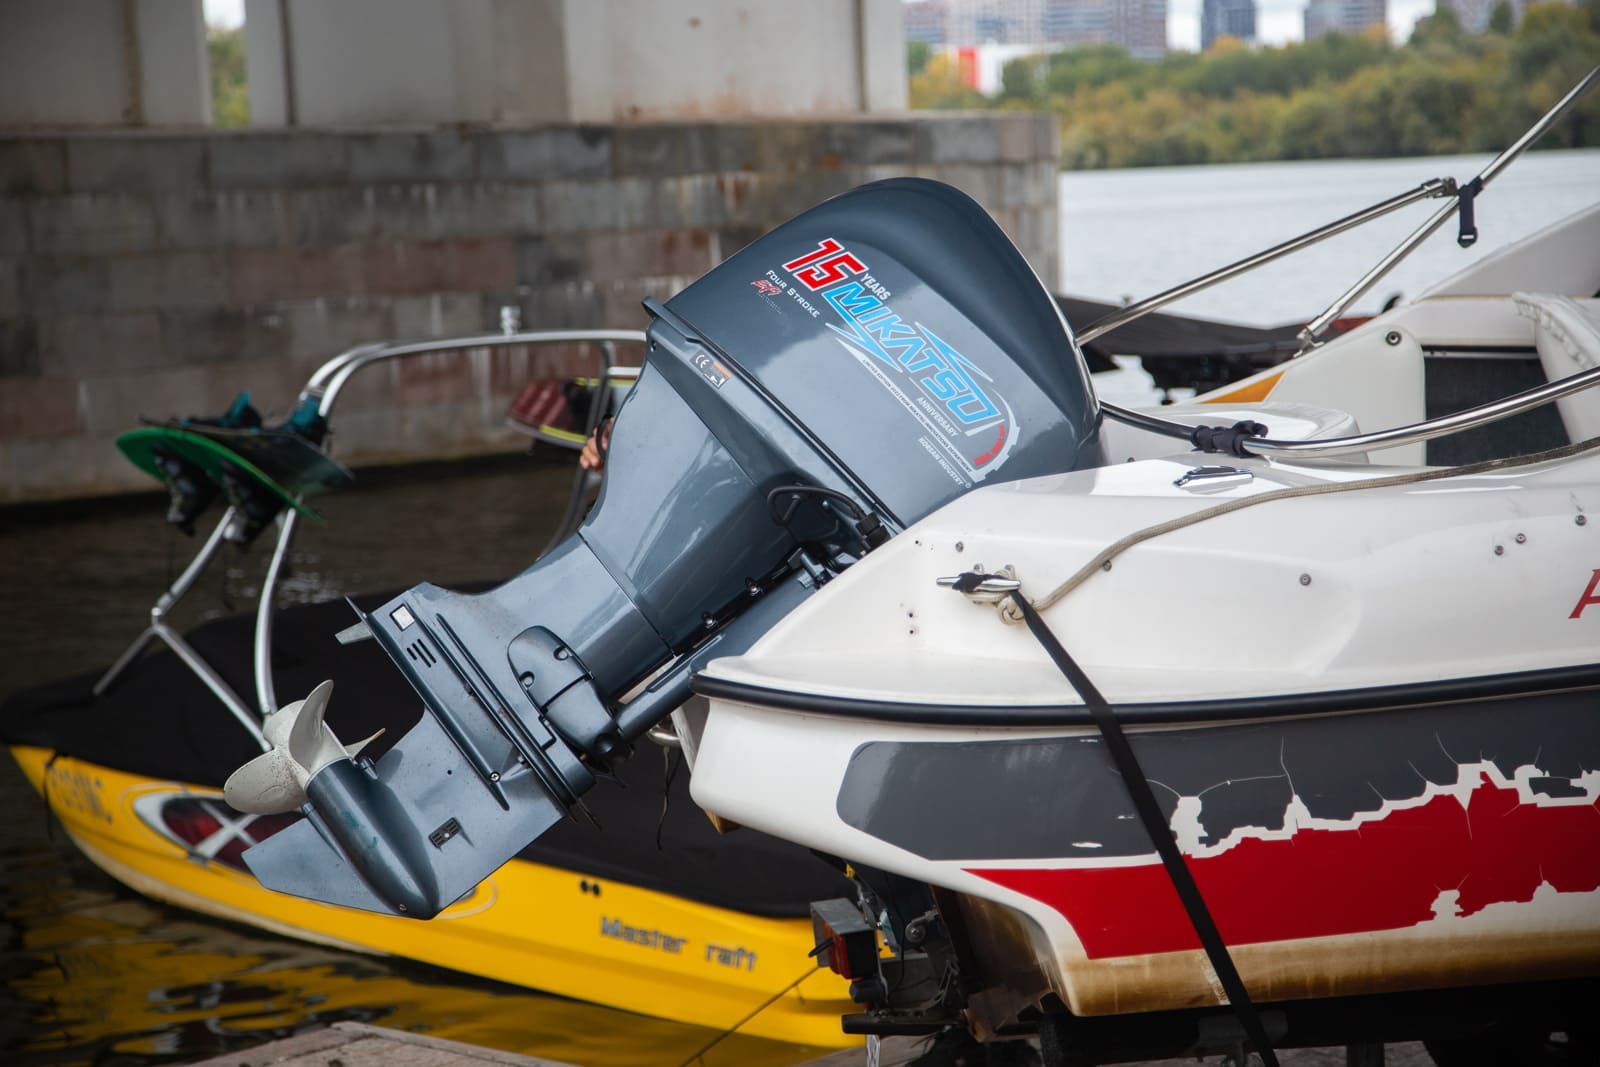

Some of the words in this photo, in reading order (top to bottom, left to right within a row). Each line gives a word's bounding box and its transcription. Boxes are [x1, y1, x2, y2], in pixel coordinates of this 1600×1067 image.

[782, 238, 869, 292] 15
[860, 273, 891, 301] YEARS
[766, 270, 788, 289] FOUR
[787, 288, 820, 318] STROKE
[917, 397, 959, 437] ANNIVERSARY
[918, 437, 941, 461] KOREAN
[939, 458, 964, 486] INDUSTRY
